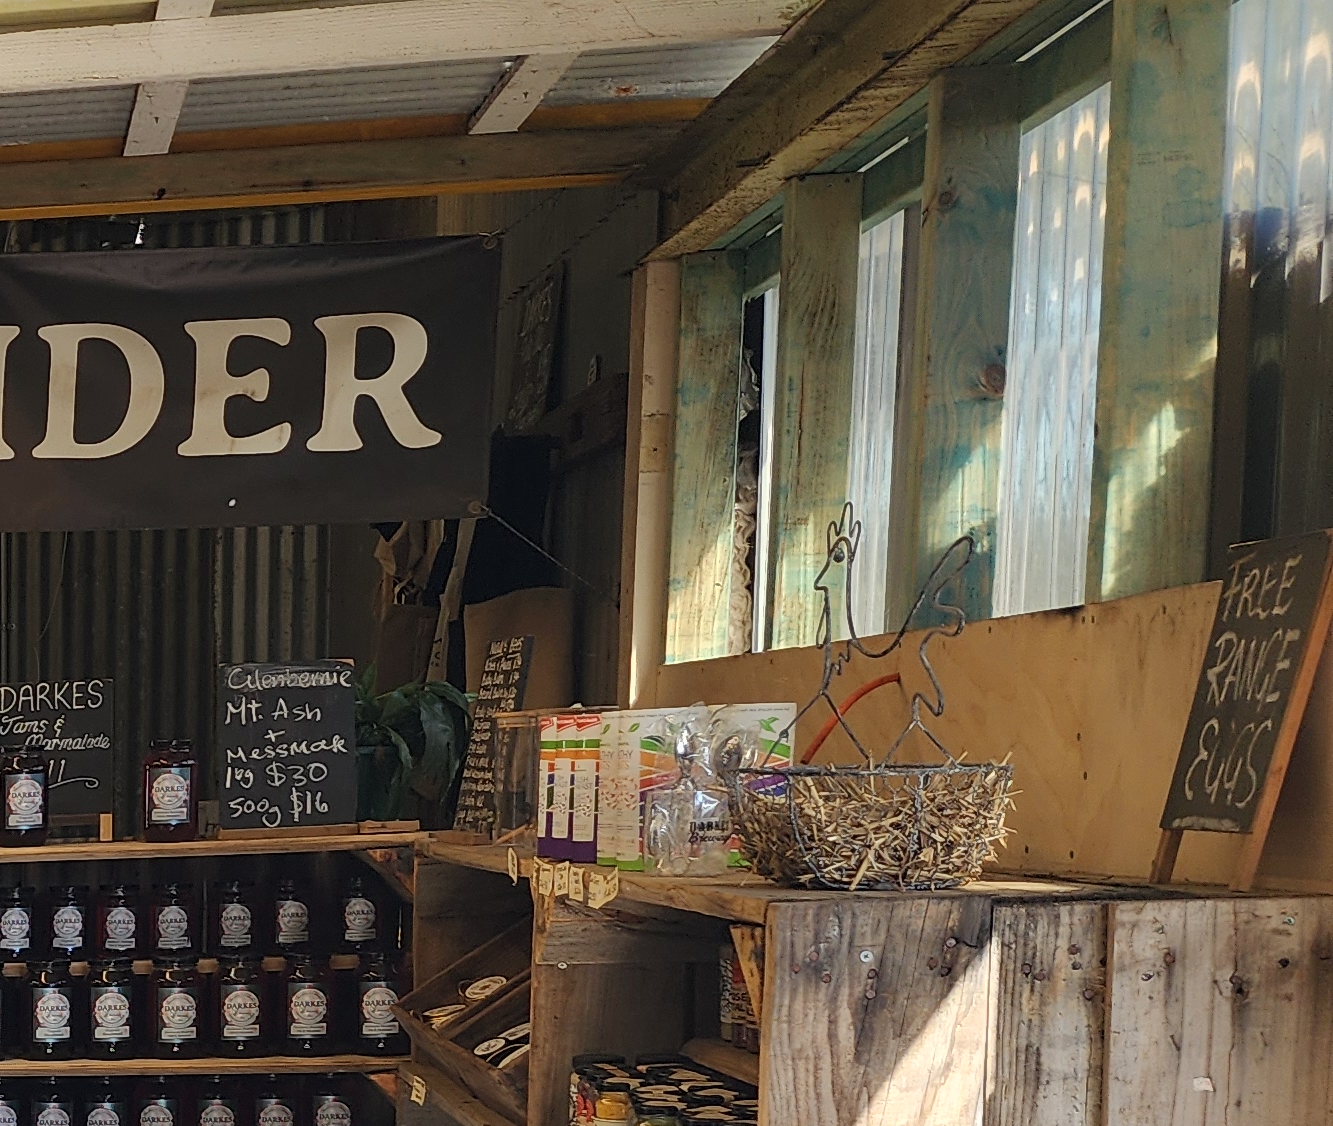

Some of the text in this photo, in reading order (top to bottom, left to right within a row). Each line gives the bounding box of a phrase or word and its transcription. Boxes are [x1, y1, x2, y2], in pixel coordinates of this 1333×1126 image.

[1222, 553, 1303, 623] FREE
[1206, 626, 1302, 713] RANGE
[224, 695, 323, 726] Mt. Ash
[0, 714, 50, 736] Jams
[263, 729, 286, 743] +
[1184, 716, 1273, 810] EGGS
[225, 761, 329, 790] 1kg $30
[227, 786, 330, 828] 500g $16
[39, 1003, 70, 1013] DARKES
[97, 1003, 128, 1013] DARKES
[164, 1004, 197, 1014] DARKES
[226, 1002, 259, 1012] DARKES
[293, 999, 326, 1009] DARKES
